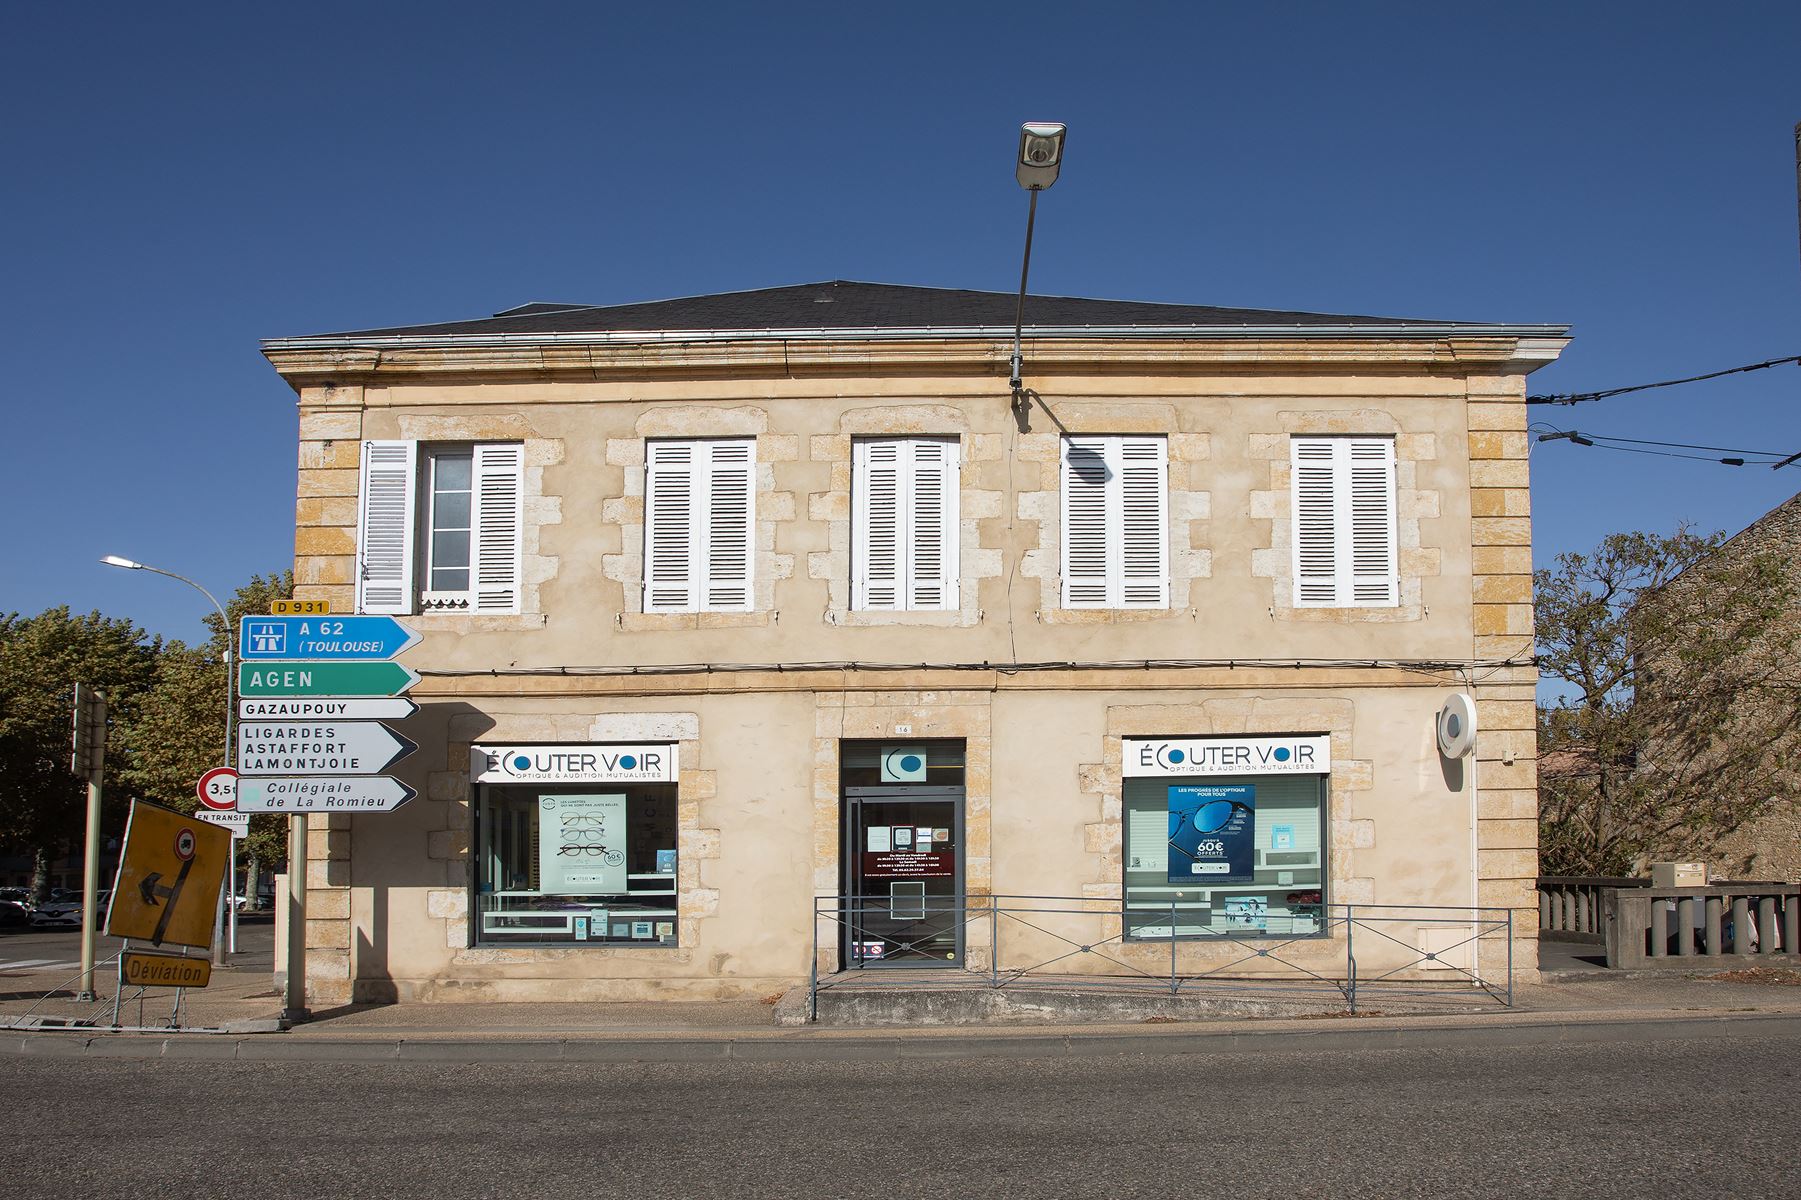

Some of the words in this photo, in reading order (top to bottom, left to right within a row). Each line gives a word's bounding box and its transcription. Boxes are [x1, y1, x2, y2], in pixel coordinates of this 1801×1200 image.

[278, 602, 287, 613] D
[292, 602, 324, 613] 931
[299, 622, 310, 635] A
[320, 622, 344, 635] 62
[299, 640, 384, 653] (TOULOUSE)
[250, 671, 312, 687] AGEN
[246, 703, 347, 715] GAZAUPOUY
[244, 728, 335, 739] LIGARDES
[244, 743, 346, 754] ASTAFFORT
[1256, 745, 1315, 763] VOIR
[244, 758, 360, 769] LAMONTJOIE
[602, 753, 661, 772] VOIR
[267, 782, 352, 796] Collégiale
[266, 796, 284, 807] de
[296, 797, 313, 807] La
[326, 796, 385, 807] Romieu
[1197, 842, 1224, 852] 60€
[130, 959, 202, 981] Déviation
